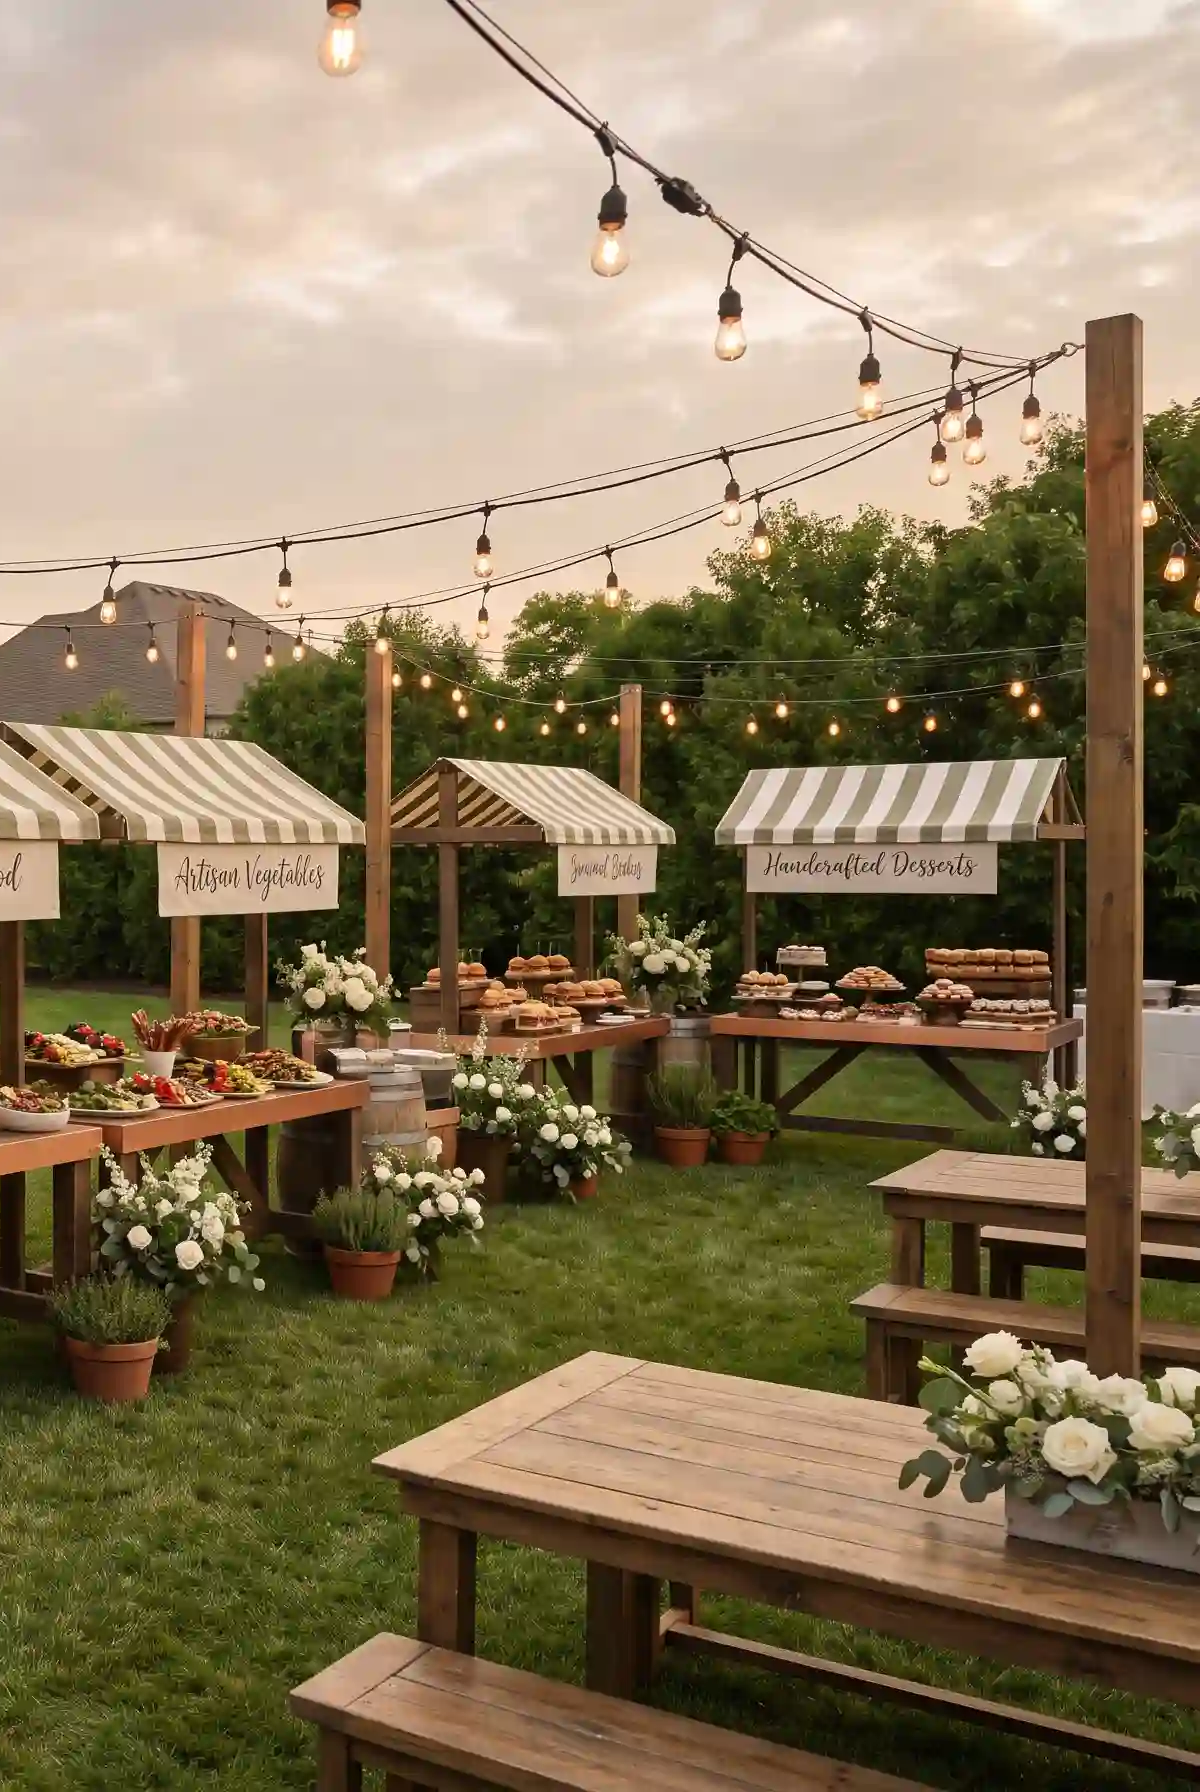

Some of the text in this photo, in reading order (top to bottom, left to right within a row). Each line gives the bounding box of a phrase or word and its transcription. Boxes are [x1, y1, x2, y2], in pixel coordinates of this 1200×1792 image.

[174, 854, 324, 901] Artisan Vegetables
[763, 850, 978, 879] Handcrafted Desserts
